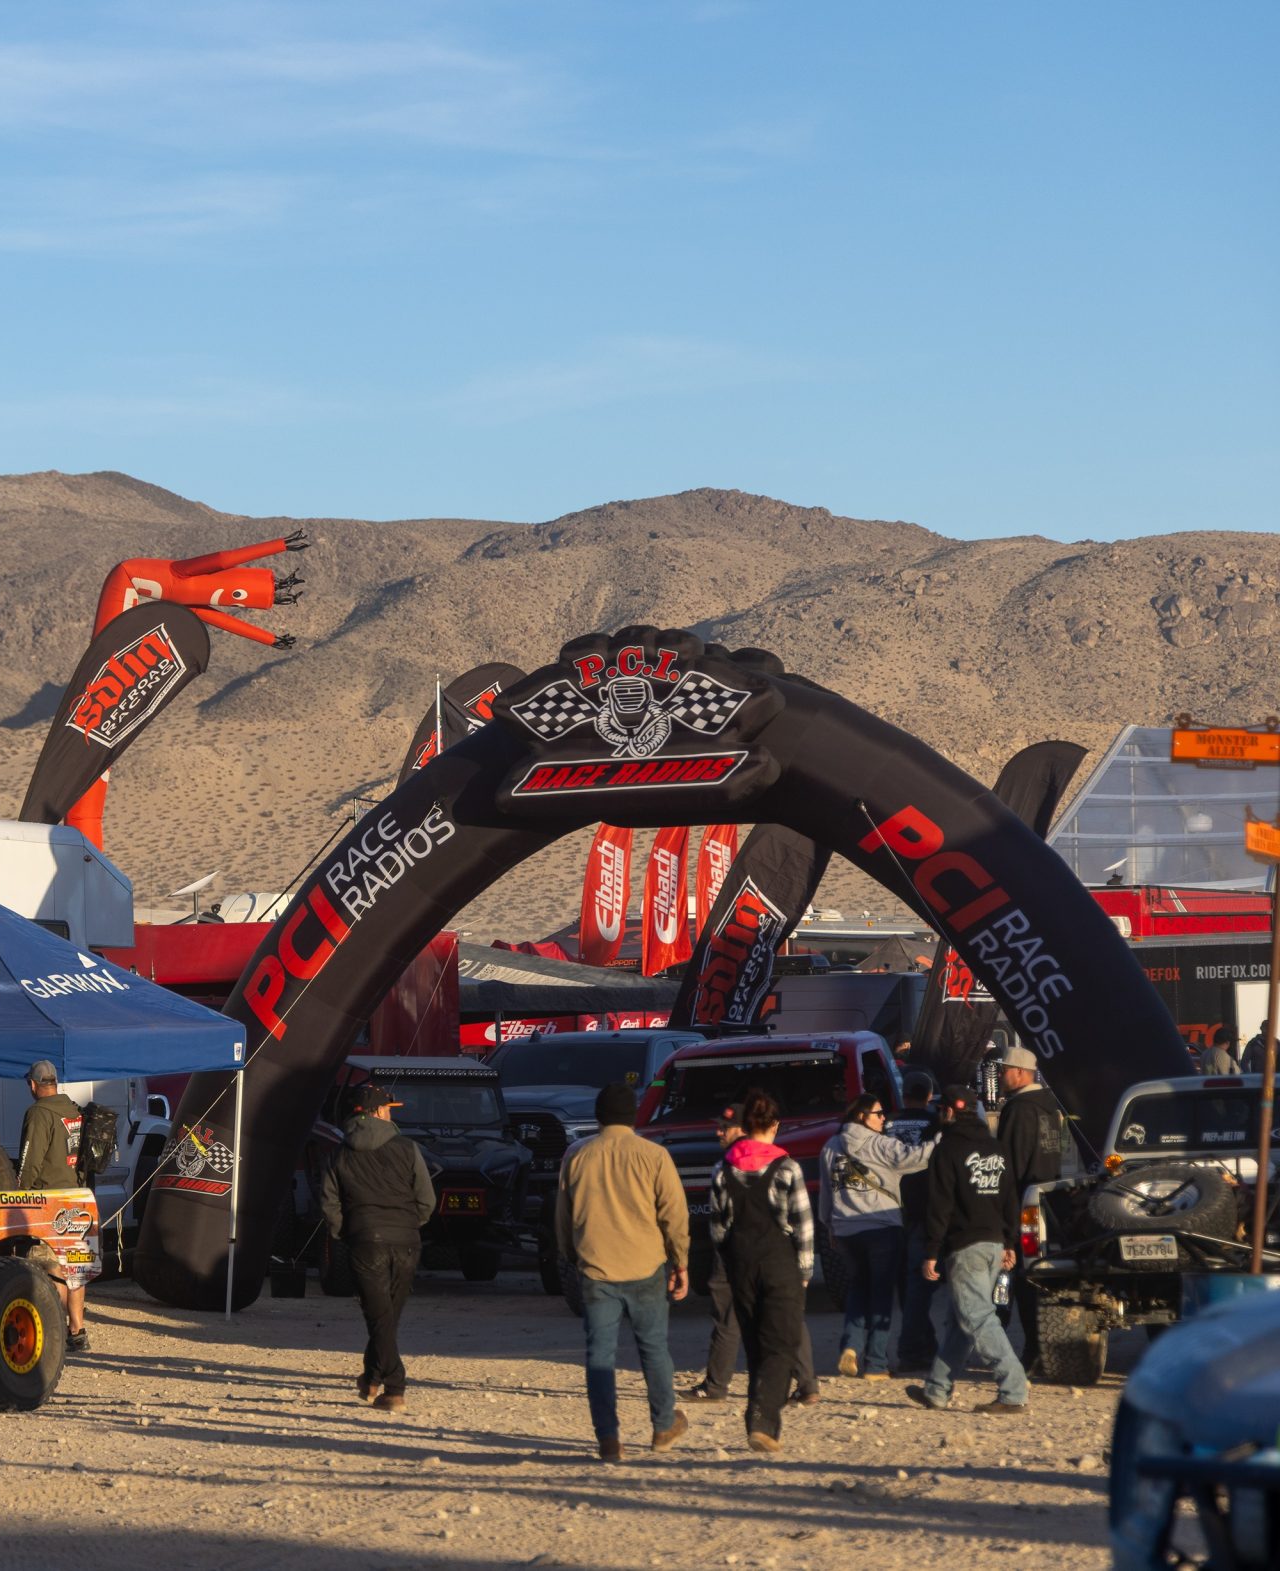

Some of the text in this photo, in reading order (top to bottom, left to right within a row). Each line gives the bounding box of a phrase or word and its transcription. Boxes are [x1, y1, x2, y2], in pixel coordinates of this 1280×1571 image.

[101, 659, 169, 732] OFFROAD
[105, 664, 174, 736] RACING
[574, 645, 682, 689] P.C.I.
[522, 757, 735, 791] RACE RADIOS
[1196, 734, 1259, 747] MONSTER
[1207, 745, 1247, 757] ALLEY
[325, 811, 402, 895] RACE
[340, 816, 456, 921] RADIOS
[705, 839, 726, 911] ibach
[857, 805, 1011, 933] PCI
[595, 839, 624, 942] Eibach
[653, 847, 678, 944] Eibach
[242, 883, 352, 1041] PCI
[604, 959, 638, 967] SUPPORT
[992, 908, 1073, 1004] RACE
[968, 929, 1065, 1059] RADIOS
[66, 1250, 96, 1263] Haltech
